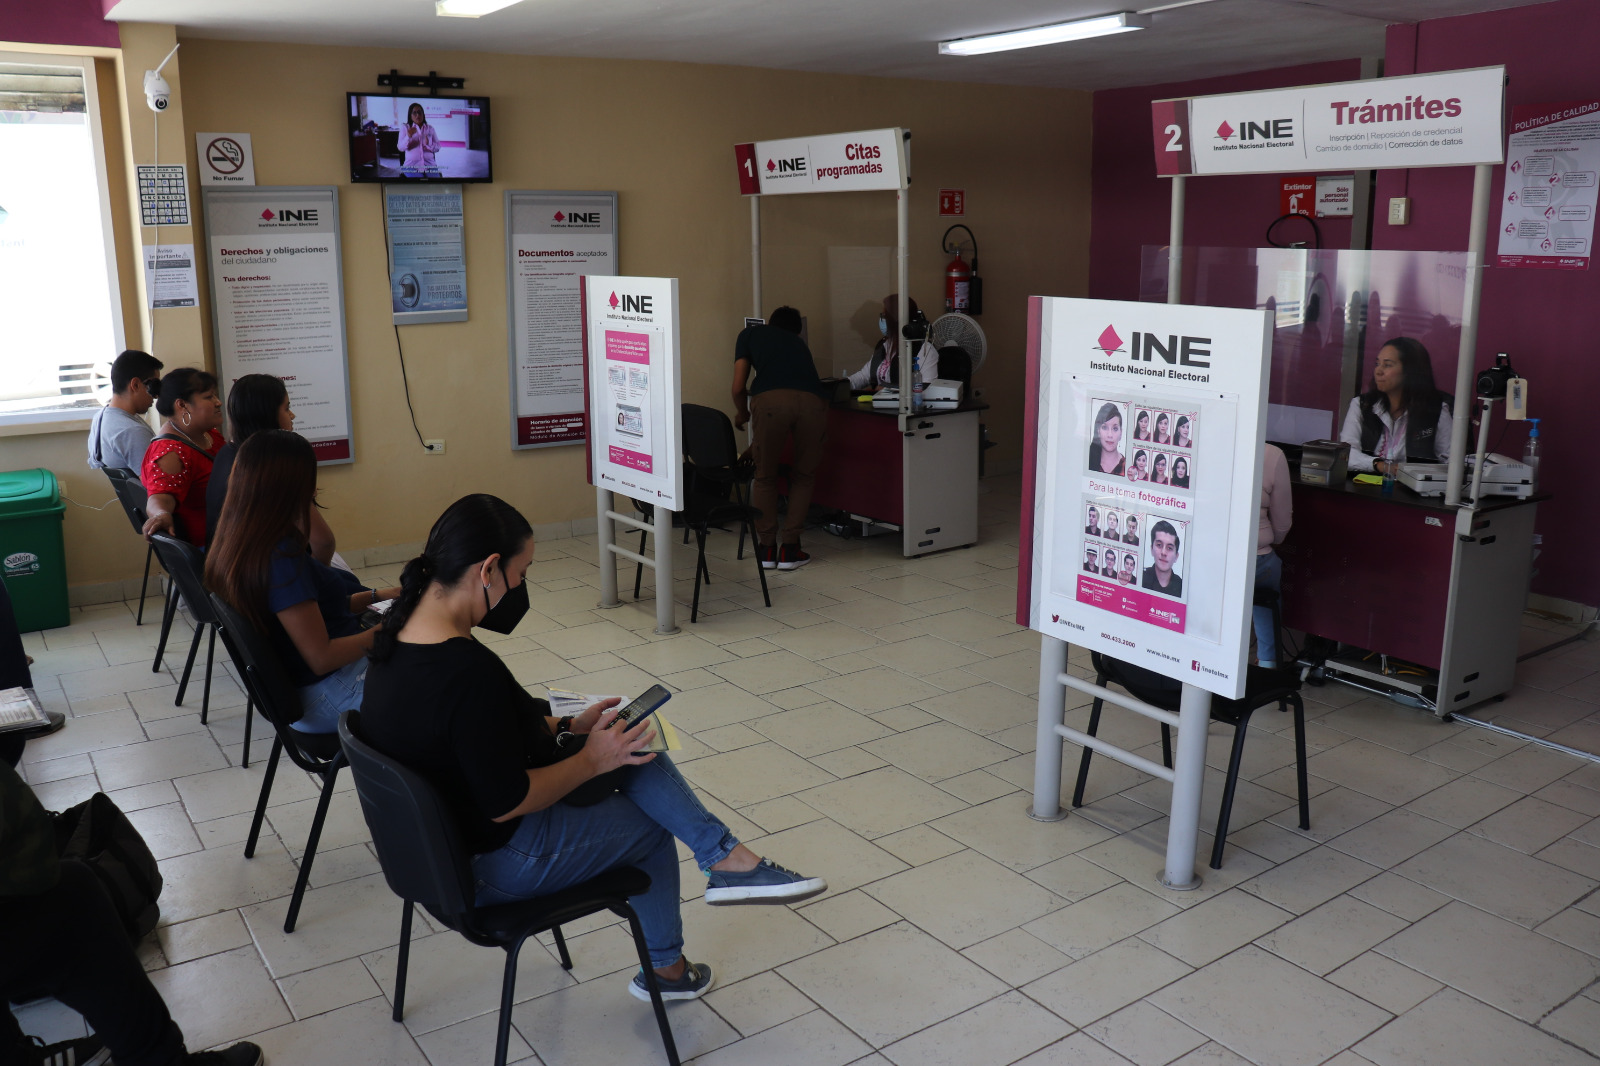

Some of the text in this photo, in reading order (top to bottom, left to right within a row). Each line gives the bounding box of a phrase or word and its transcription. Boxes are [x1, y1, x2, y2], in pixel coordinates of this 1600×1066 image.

[1330, 94, 1462, 126] Trámites
[1515, 102, 1599, 130] POLÍTICA DE CALIDAD
[1239, 118, 1293, 141] INE
[1370, 126, 1463, 141] Reposición de credencial
[1164, 124, 1183, 152] 2
[1238, 142, 1265, 150] Nacional
[1266, 140, 1294, 149] Electoral
[1329, 133, 1365, 142] Inscripción
[1388, 138, 1463, 149] Corrección de datos
[845, 143, 881, 161] Citas
[1315, 145, 1341, 153] Cambio
[1352, 142, 1383, 151] domicilio
[744, 158, 753, 178] 1
[778, 157, 806, 172] INE
[816, 161, 883, 181] programadas
[1283, 183, 1312, 191] Extintor
[279, 209, 318, 221] INE
[568, 212, 600, 223] INE
[220, 248, 264, 256] Derechos
[273, 246, 329, 255] obligaciones
[518, 249, 574, 257] Documentos
[222, 256, 277, 265] del ciudadano
[427, 291, 463, 300] PROTEGIDOS
[621, 294, 653, 314] INE
[1131, 331, 1212, 369] INE
[1090, 360, 1210, 383] Instituto Nacional Electoral
[1089, 481, 1186, 509] Para la toma fotográfica
[6, 553, 31, 565] Sablón
[1100, 632, 1136, 649] 800.433.2000
[1146, 648, 1181, 664] www.ine.mx
